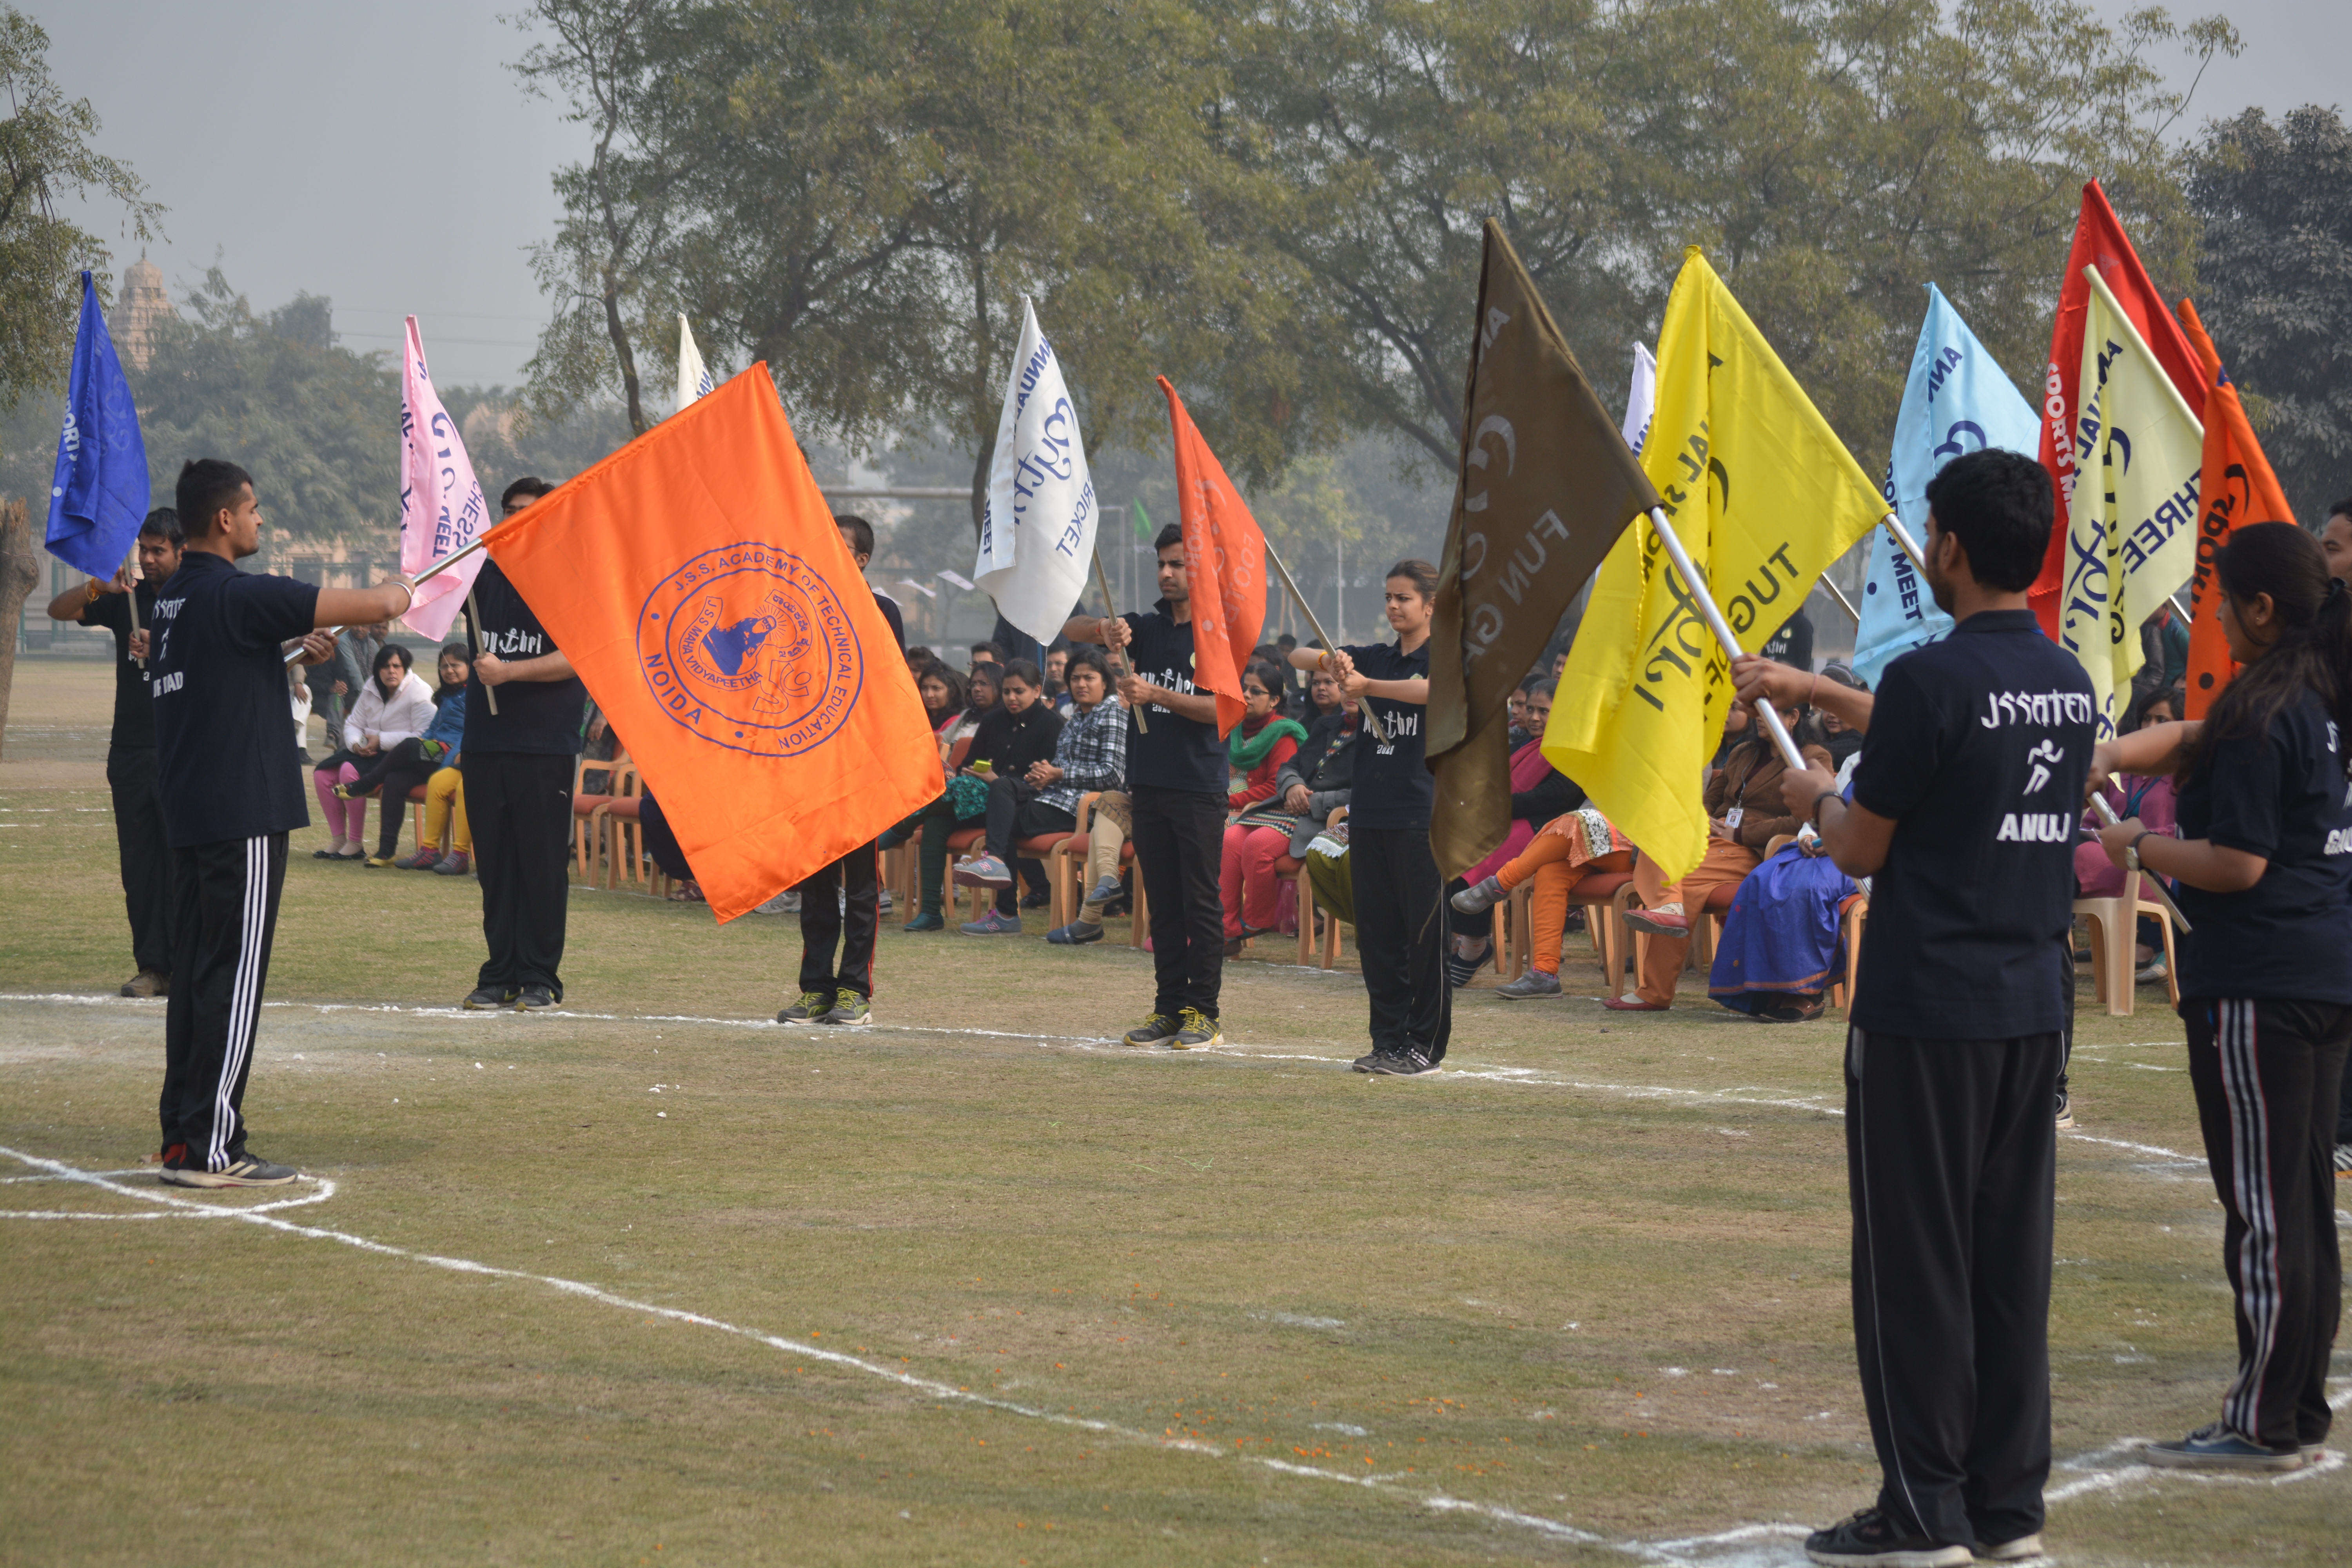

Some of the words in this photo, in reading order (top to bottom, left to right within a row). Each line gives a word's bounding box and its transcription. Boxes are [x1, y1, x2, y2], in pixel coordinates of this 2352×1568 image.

[675, 563, 715, 591] J.S.S.
[719, 551, 799, 575] ACADEMY
[802, 575, 820, 595] OF
[682, 626, 702, 655] MAHA
[817, 596, 852, 682] TECHNICAL
[686, 655, 763, 688] VIDYAPEETHA
[646, 653, 702, 725] NOIDA
[778, 686, 847, 750] EDUCATION
[1981, 689, 2092, 729] JSSATEN
[1996, 813, 2071, 842] ANUJ
